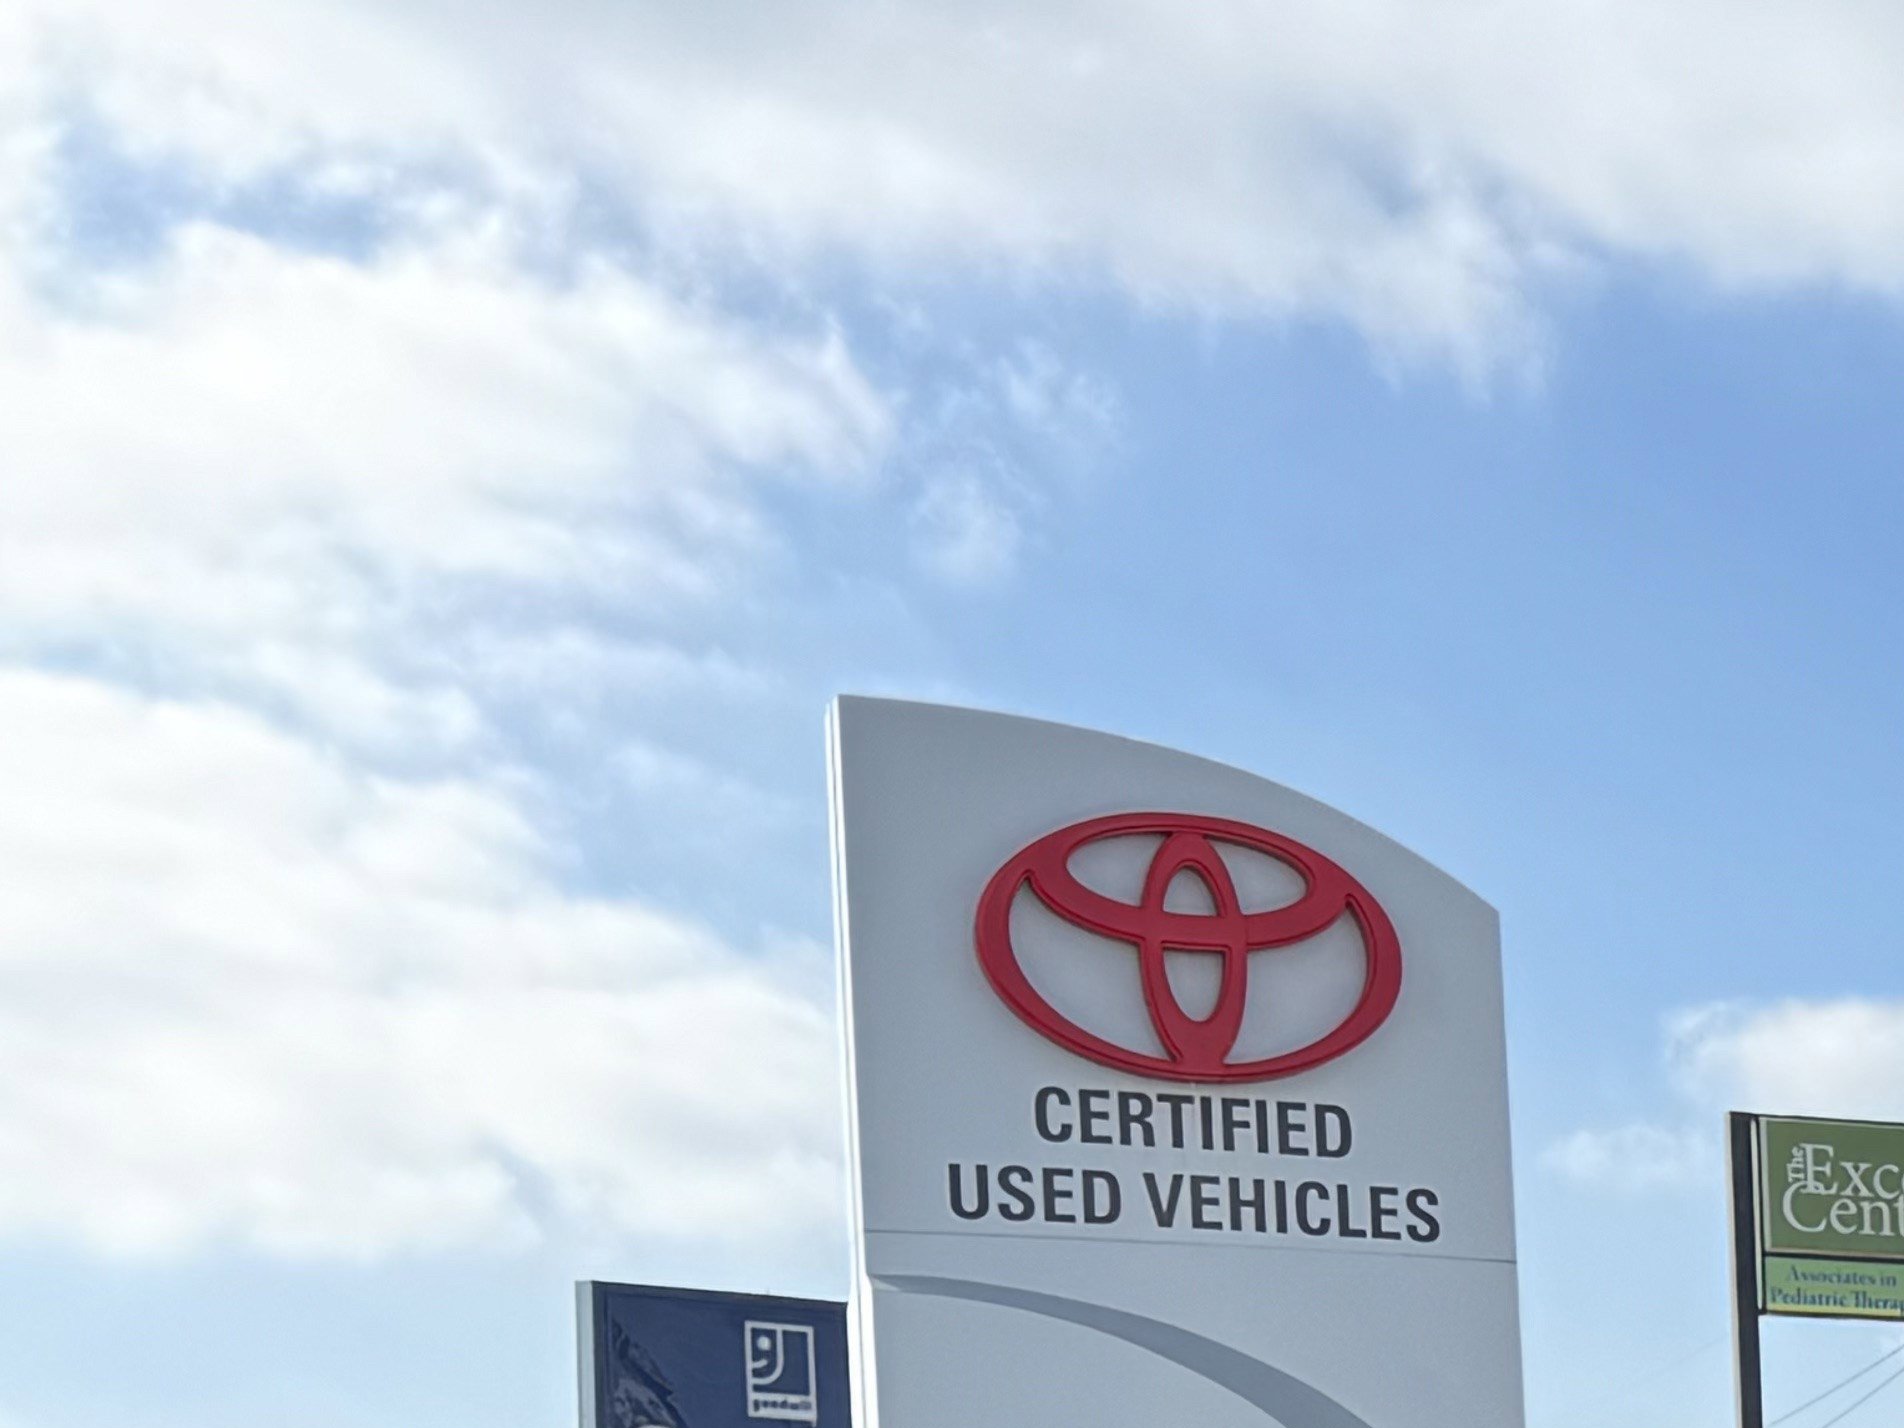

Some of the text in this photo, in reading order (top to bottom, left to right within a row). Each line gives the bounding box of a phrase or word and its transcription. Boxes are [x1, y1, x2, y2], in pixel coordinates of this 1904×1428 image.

[1034, 1086, 1352, 1158] CERTIFIED
[1787, 1146, 1805, 1183] The
[947, 1163, 1440, 1243] USED VEHICLES
[1787, 1265, 1897, 1287] Associates in
[1770, 1288, 1846, 1307] Pediatric
